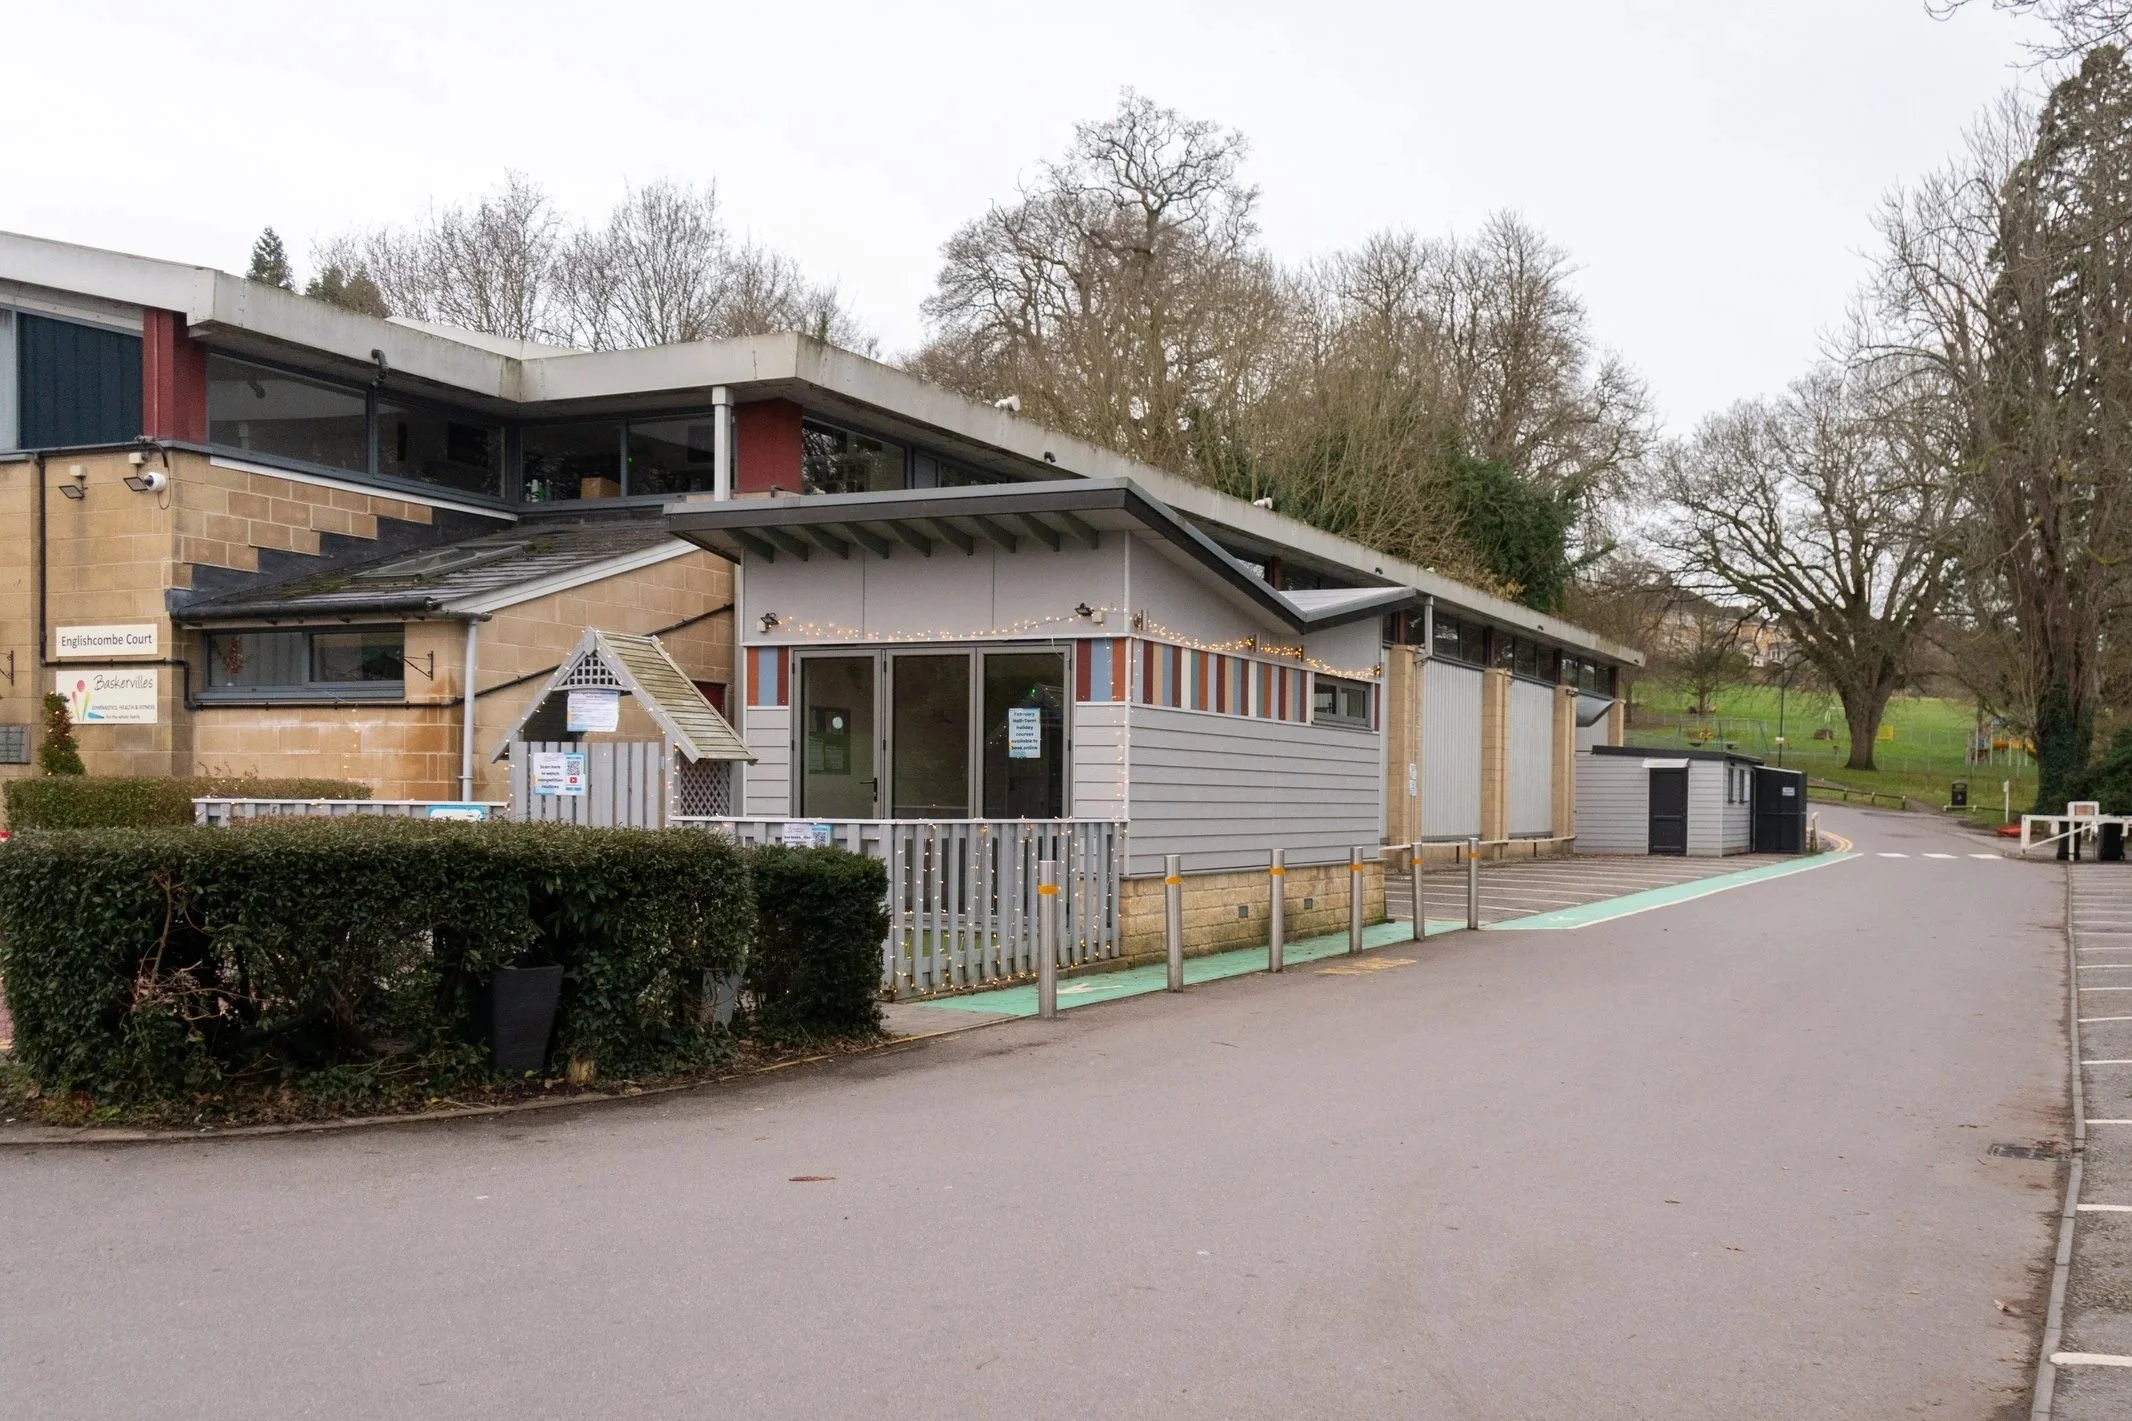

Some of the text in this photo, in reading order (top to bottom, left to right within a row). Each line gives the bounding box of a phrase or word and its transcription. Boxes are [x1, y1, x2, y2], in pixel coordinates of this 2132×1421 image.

[61, 634, 152, 648] Englishcombe Court
[94, 674, 153, 690] Baskervilles
